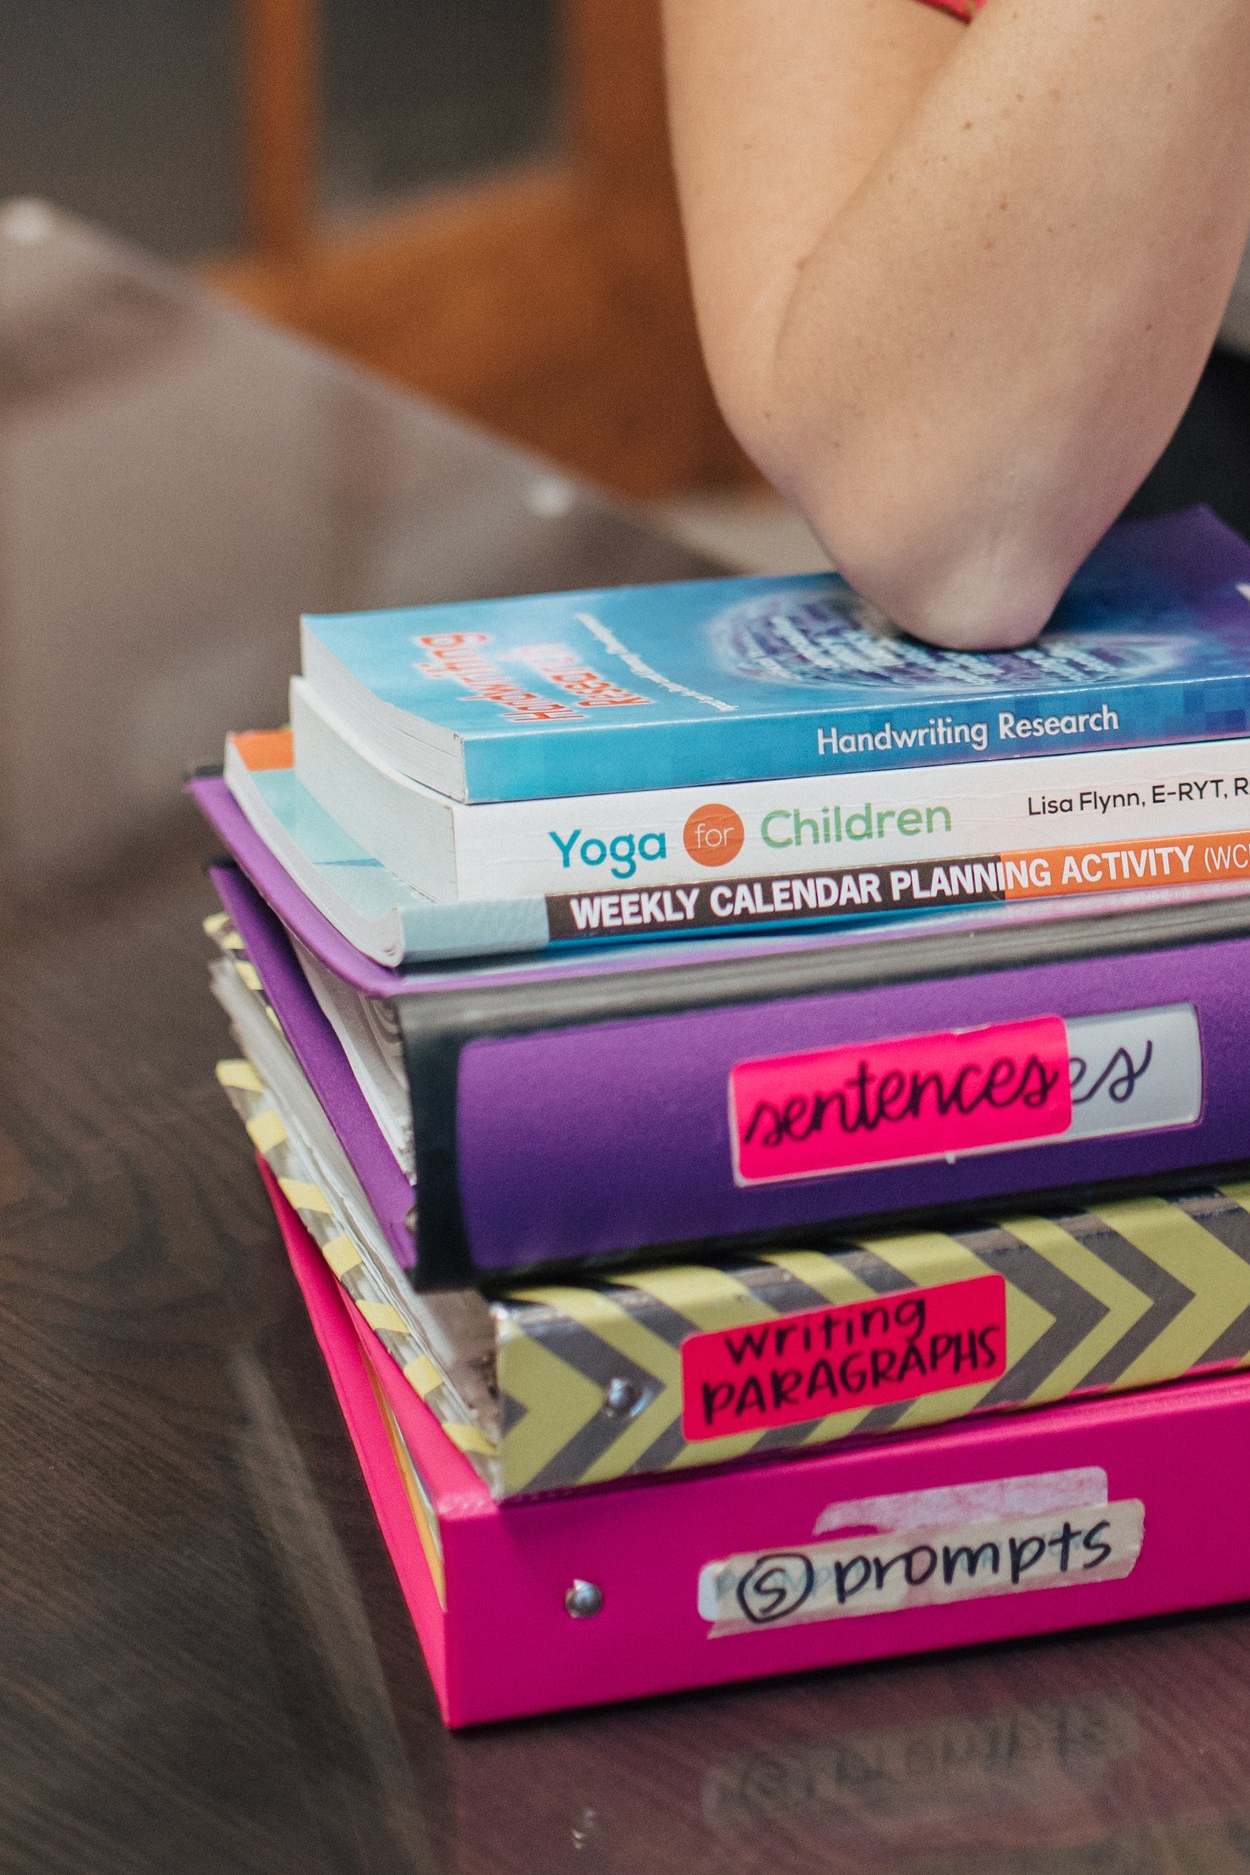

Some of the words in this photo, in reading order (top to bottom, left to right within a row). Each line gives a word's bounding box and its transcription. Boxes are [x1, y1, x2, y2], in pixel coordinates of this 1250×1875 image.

[817, 717, 988, 755] Handwriting
[999, 704, 1119, 739] Research
[1028, 796, 1073, 816] Lisa
[1079, 791, 1146, 814] Flynn,
[1152, 779, 1228, 804] E-RYT,
[548, 828, 667, 879] Yoga
[694, 822, 736, 849] for
[760, 802, 952, 849] Children
[570, 888, 700, 930] WEEKLY
[709, 873, 882, 917] CALENDAR
[891, 857, 1052, 901] PLANNING
[1061, 845, 1194, 884] ACTIVITY
[743, 1055, 1059, 1147] sentences
[724, 1297, 926, 1365] writing
[702, 1325, 999, 1425] PARAGRAPHS
[834, 1520, 1113, 1605] prompts
